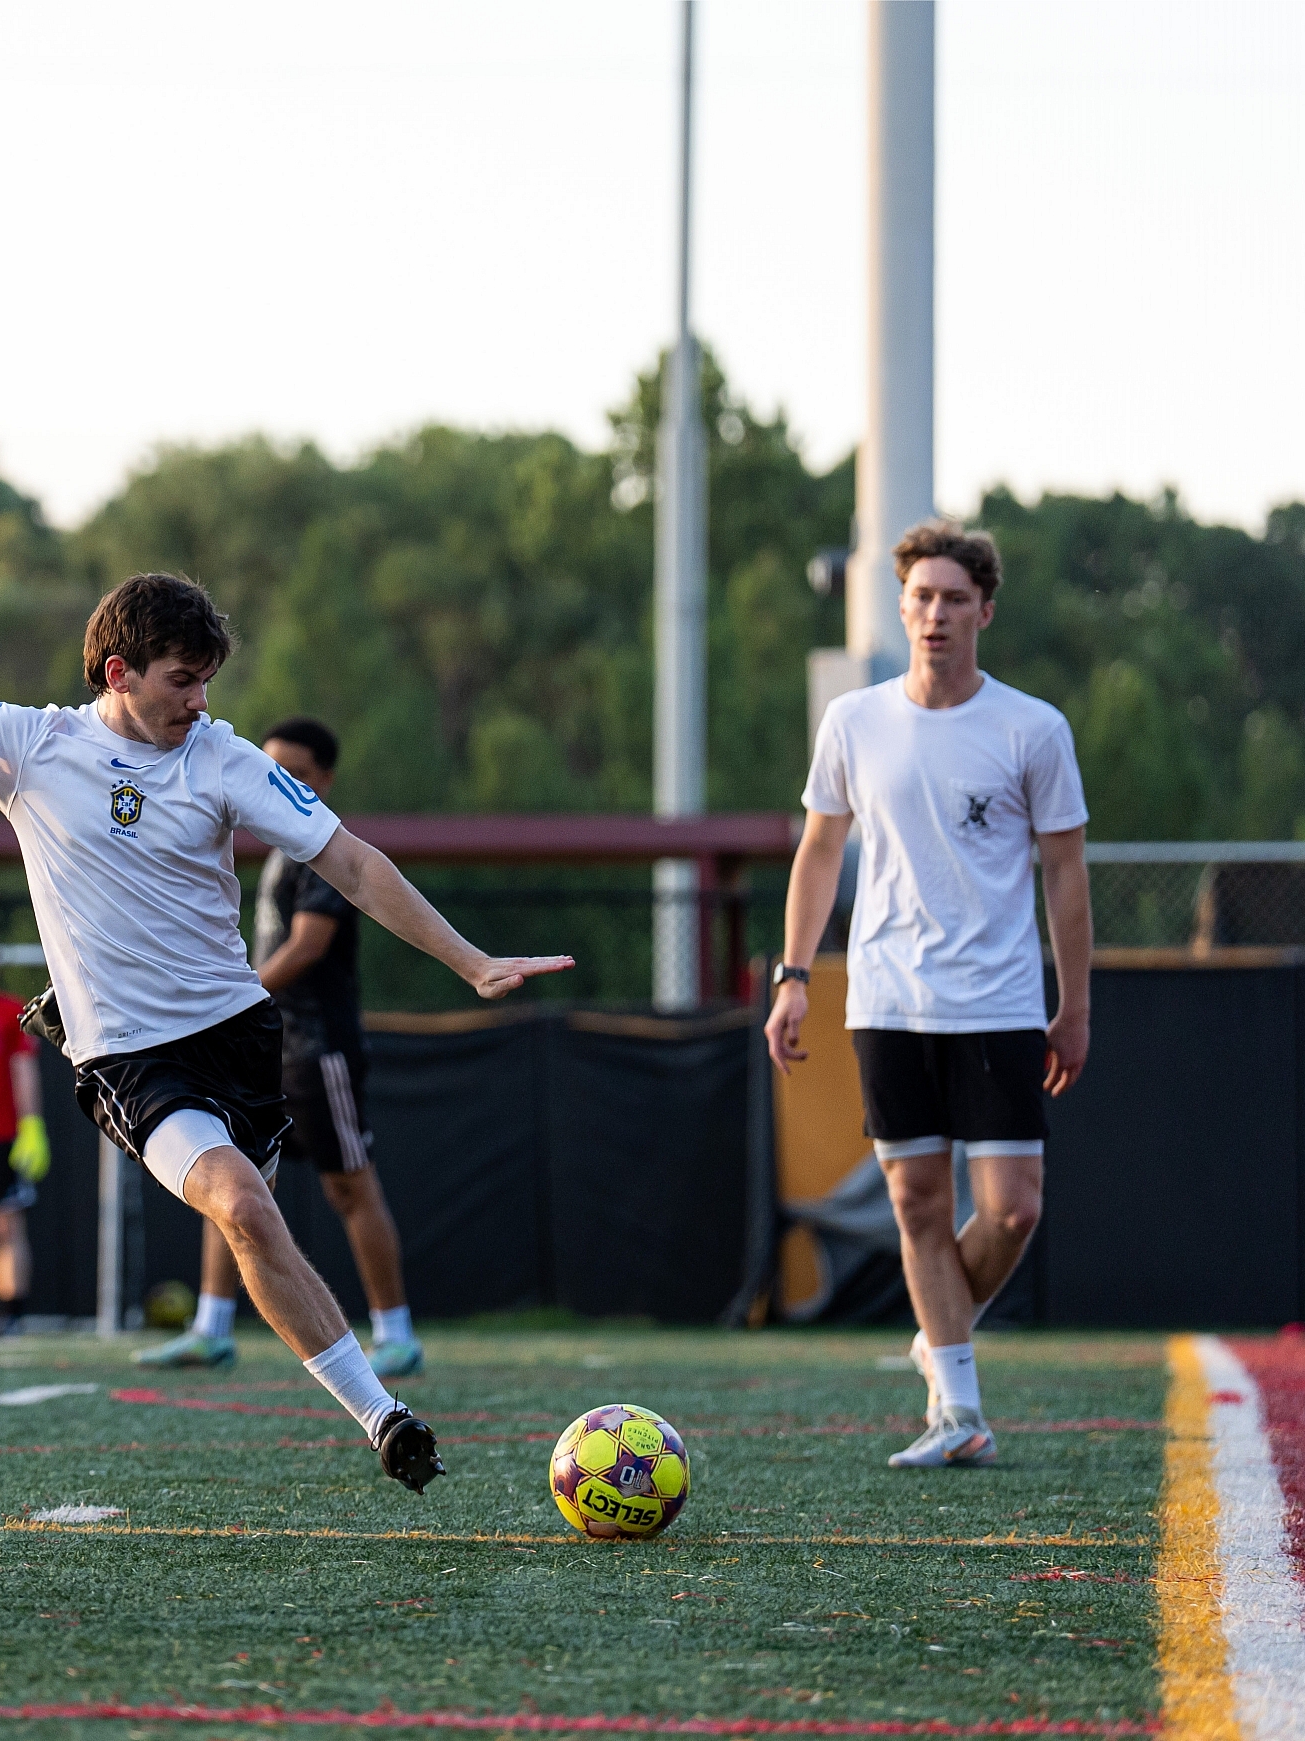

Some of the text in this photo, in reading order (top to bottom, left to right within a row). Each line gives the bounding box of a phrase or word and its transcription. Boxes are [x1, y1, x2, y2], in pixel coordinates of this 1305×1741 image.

[110, 827, 139, 839] BRASIL
[117, 1027, 142, 1039] DRI-FIT
[627, 1427, 659, 1444] PITCHES
[635, 1441, 656, 1450] SONS
[619, 1465, 643, 1489] 10
[582, 1487, 657, 1526] SELECT
